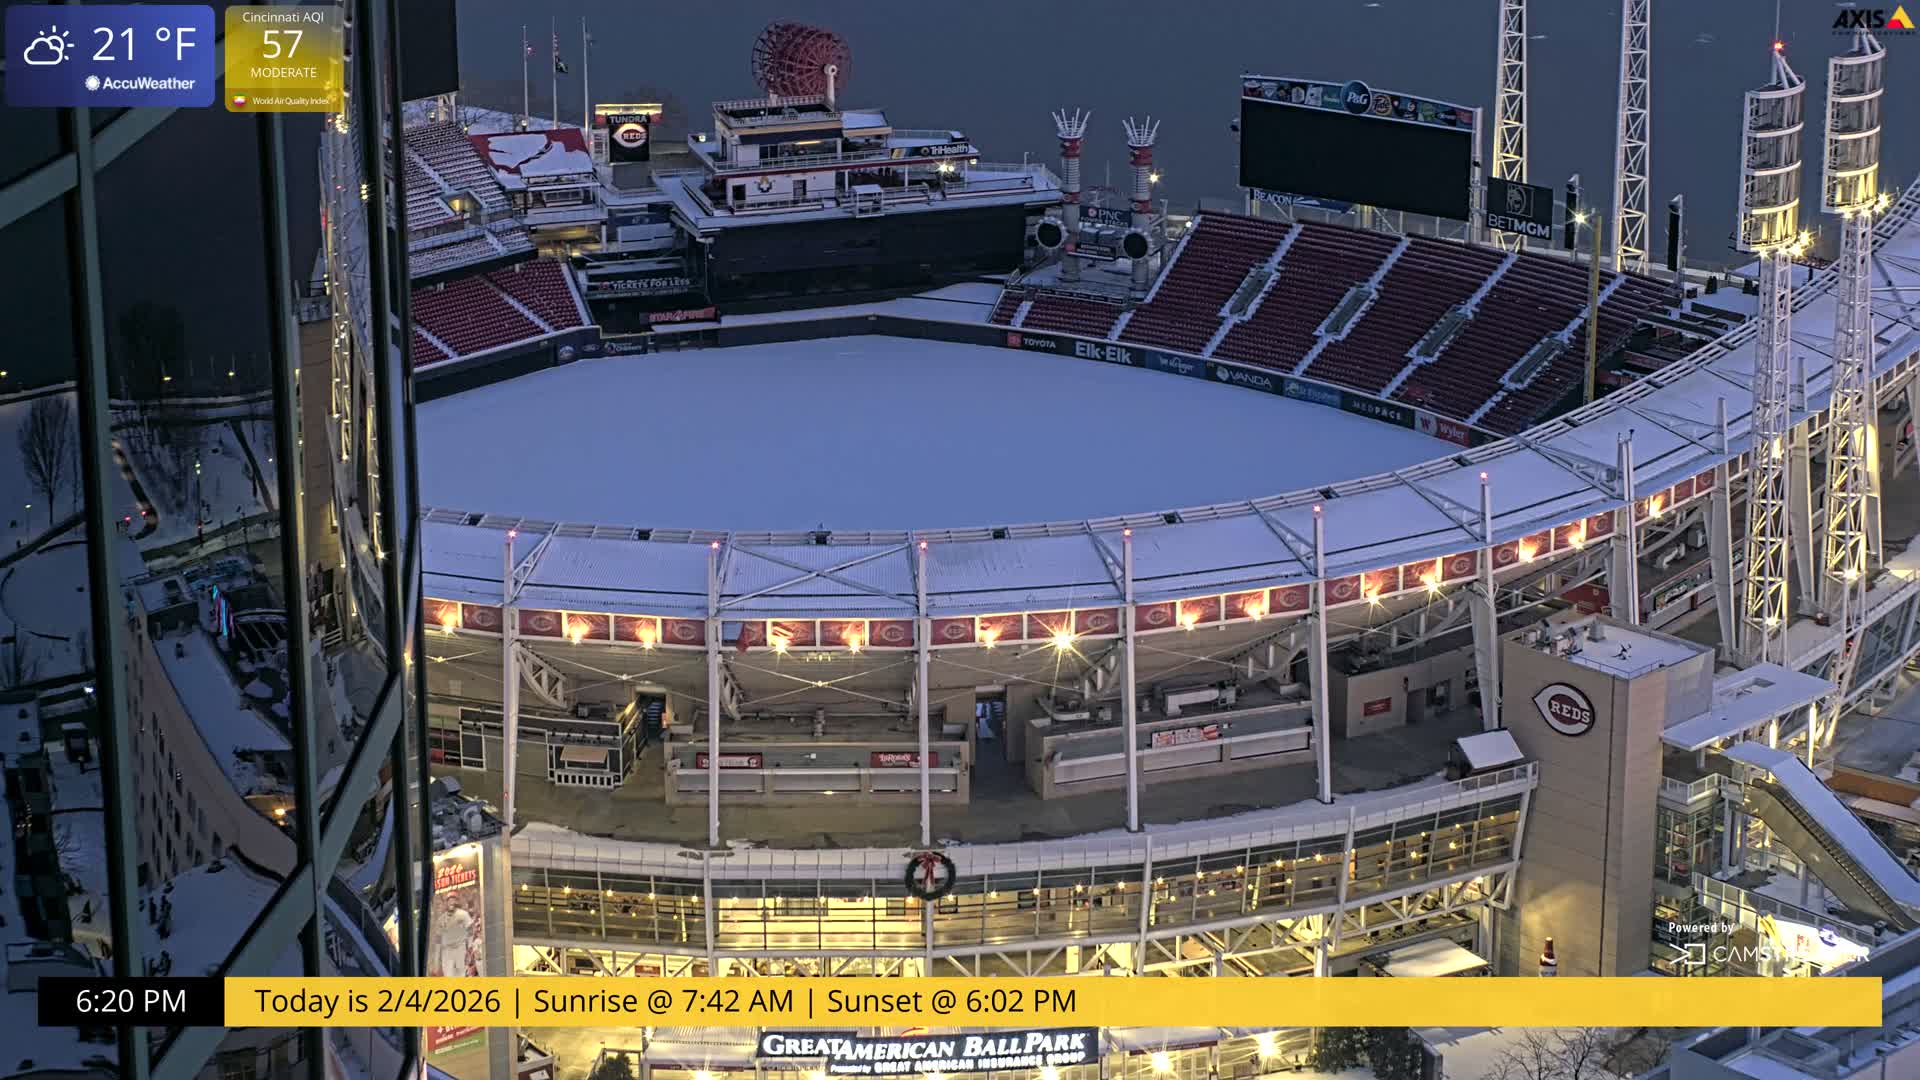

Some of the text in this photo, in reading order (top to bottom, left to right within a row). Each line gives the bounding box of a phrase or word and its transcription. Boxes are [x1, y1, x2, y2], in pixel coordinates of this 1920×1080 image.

[1346, 91, 1369, 105] P&G
[609, 115, 648, 124] TUNDRA
[622, 132, 647, 140] REDS
[929, 143, 968, 155] TriHealth
[1253, 188, 1293, 206] BEACON
[1098, 208, 1122, 221] PNC
[1488, 213, 1550, 238] BETMGM
[612, 278, 691, 290] TICKETS FOR LESS
[1023, 337, 1056, 349] TOYOTA
[1229, 371, 1273, 388] VANDA
[1351, 399, 1402, 420] MEDPACE
[1550, 700, 1590, 724] REDS
[762, 1032, 1086, 1061] GREAT AMERICAN BALL PARK
[874, 1061, 911, 1075] GREAT
[914, 1057, 974, 1073] AMERICAN
[977, 1054, 1043, 1070] INSURANCE
[1046, 1050, 1086, 1066] GROUP
